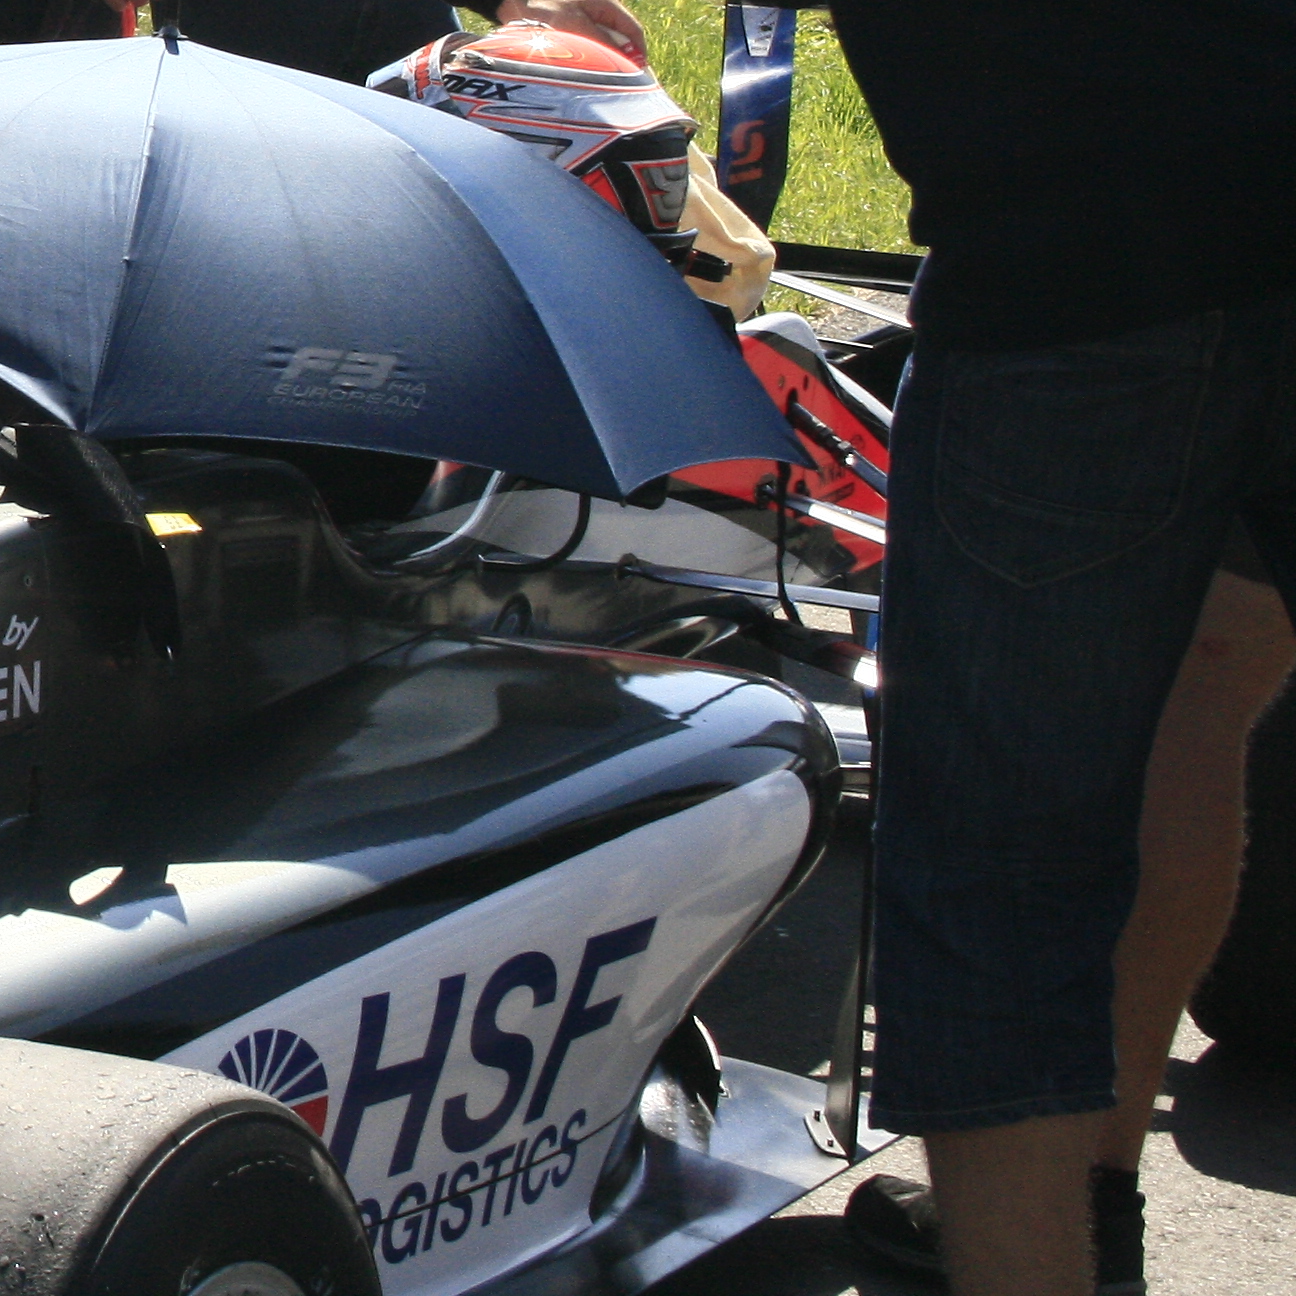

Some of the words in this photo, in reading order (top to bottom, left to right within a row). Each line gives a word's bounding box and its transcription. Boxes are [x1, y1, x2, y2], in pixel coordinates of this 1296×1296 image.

[272, 383, 425, 410] EUROPEAN
[3, 613, 40, 651] by
[329, 915, 657, 1178] HSF
